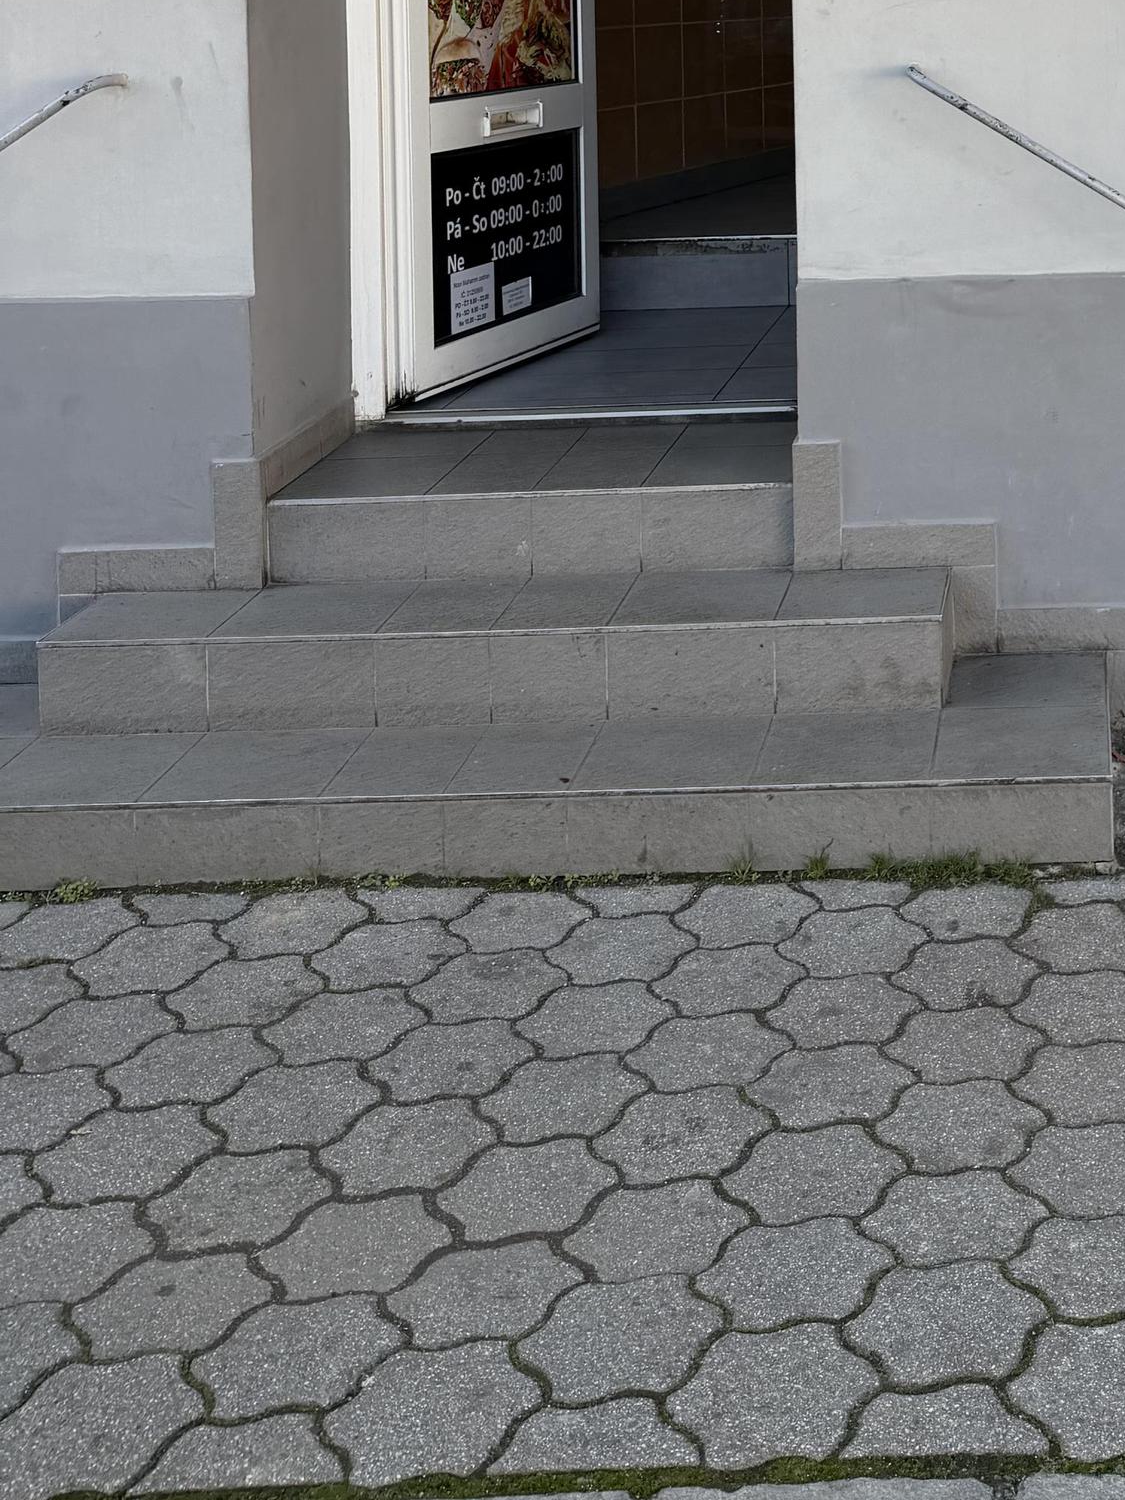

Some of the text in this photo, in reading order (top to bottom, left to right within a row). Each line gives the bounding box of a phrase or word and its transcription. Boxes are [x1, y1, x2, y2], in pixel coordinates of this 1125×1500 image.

[446, 187, 462, 207] Po
[472, 176, 486, 200] Čt
[492, 172, 524, 196] 09:00
[447, 218, 462, 241] Pá
[472, 214, 488, 234] So
[490, 204, 523, 229] 09:00
[448, 224, 562, 275] Ne 10:00 22:00
